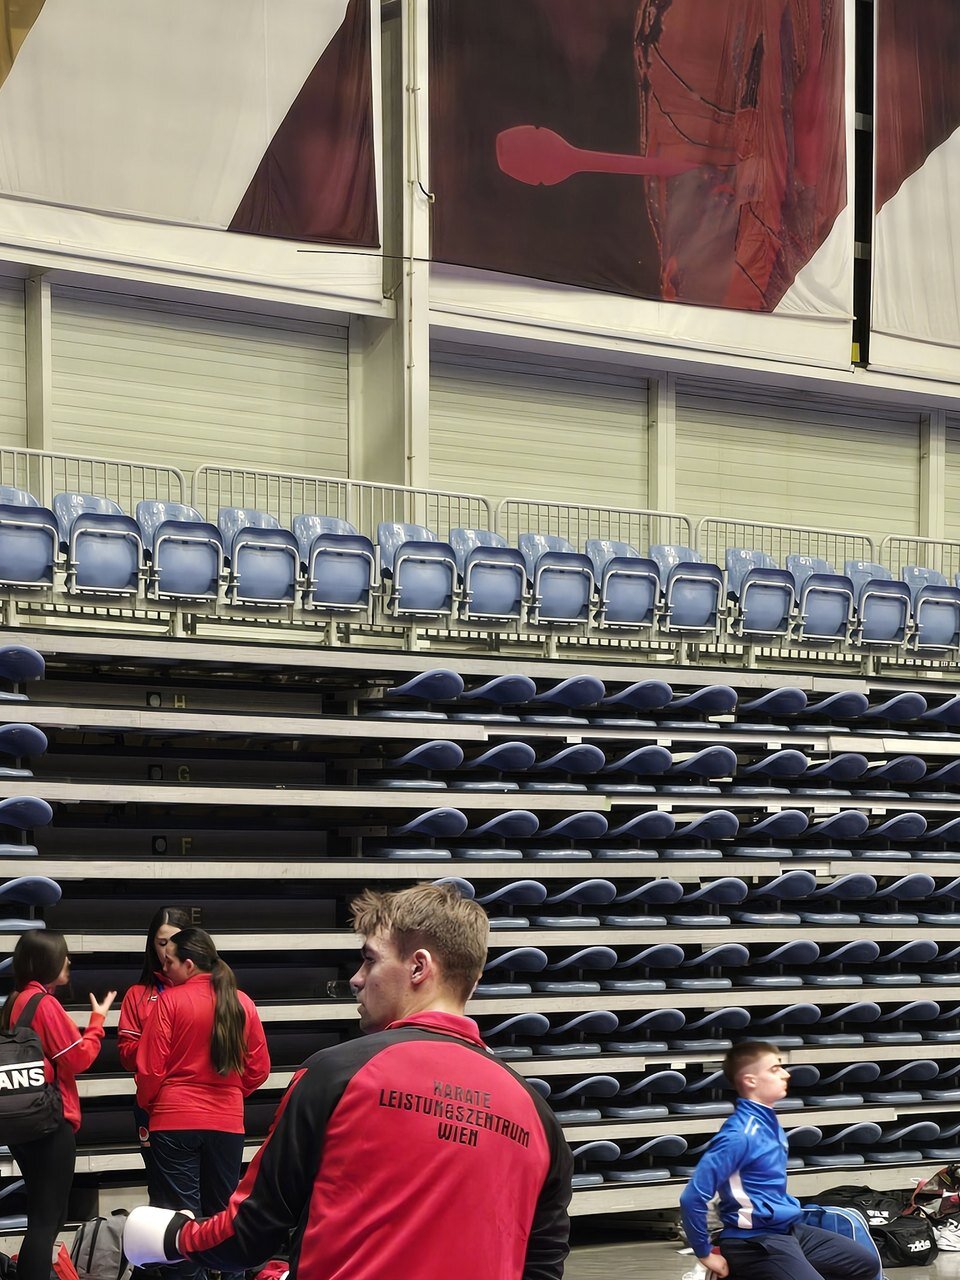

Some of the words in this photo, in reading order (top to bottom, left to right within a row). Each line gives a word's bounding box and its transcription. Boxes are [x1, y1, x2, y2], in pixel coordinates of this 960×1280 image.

[174, 694, 185, 709] H
[178, 765, 190, 782] G
[182, 837, 192, 855] F
[191, 907, 201, 925] E
[433, 1080, 492, 1109] KARATE
[379, 1088, 530, 1149] LEISTUNGSZENTRUM
[437, 1121, 479, 1147] WIEN
